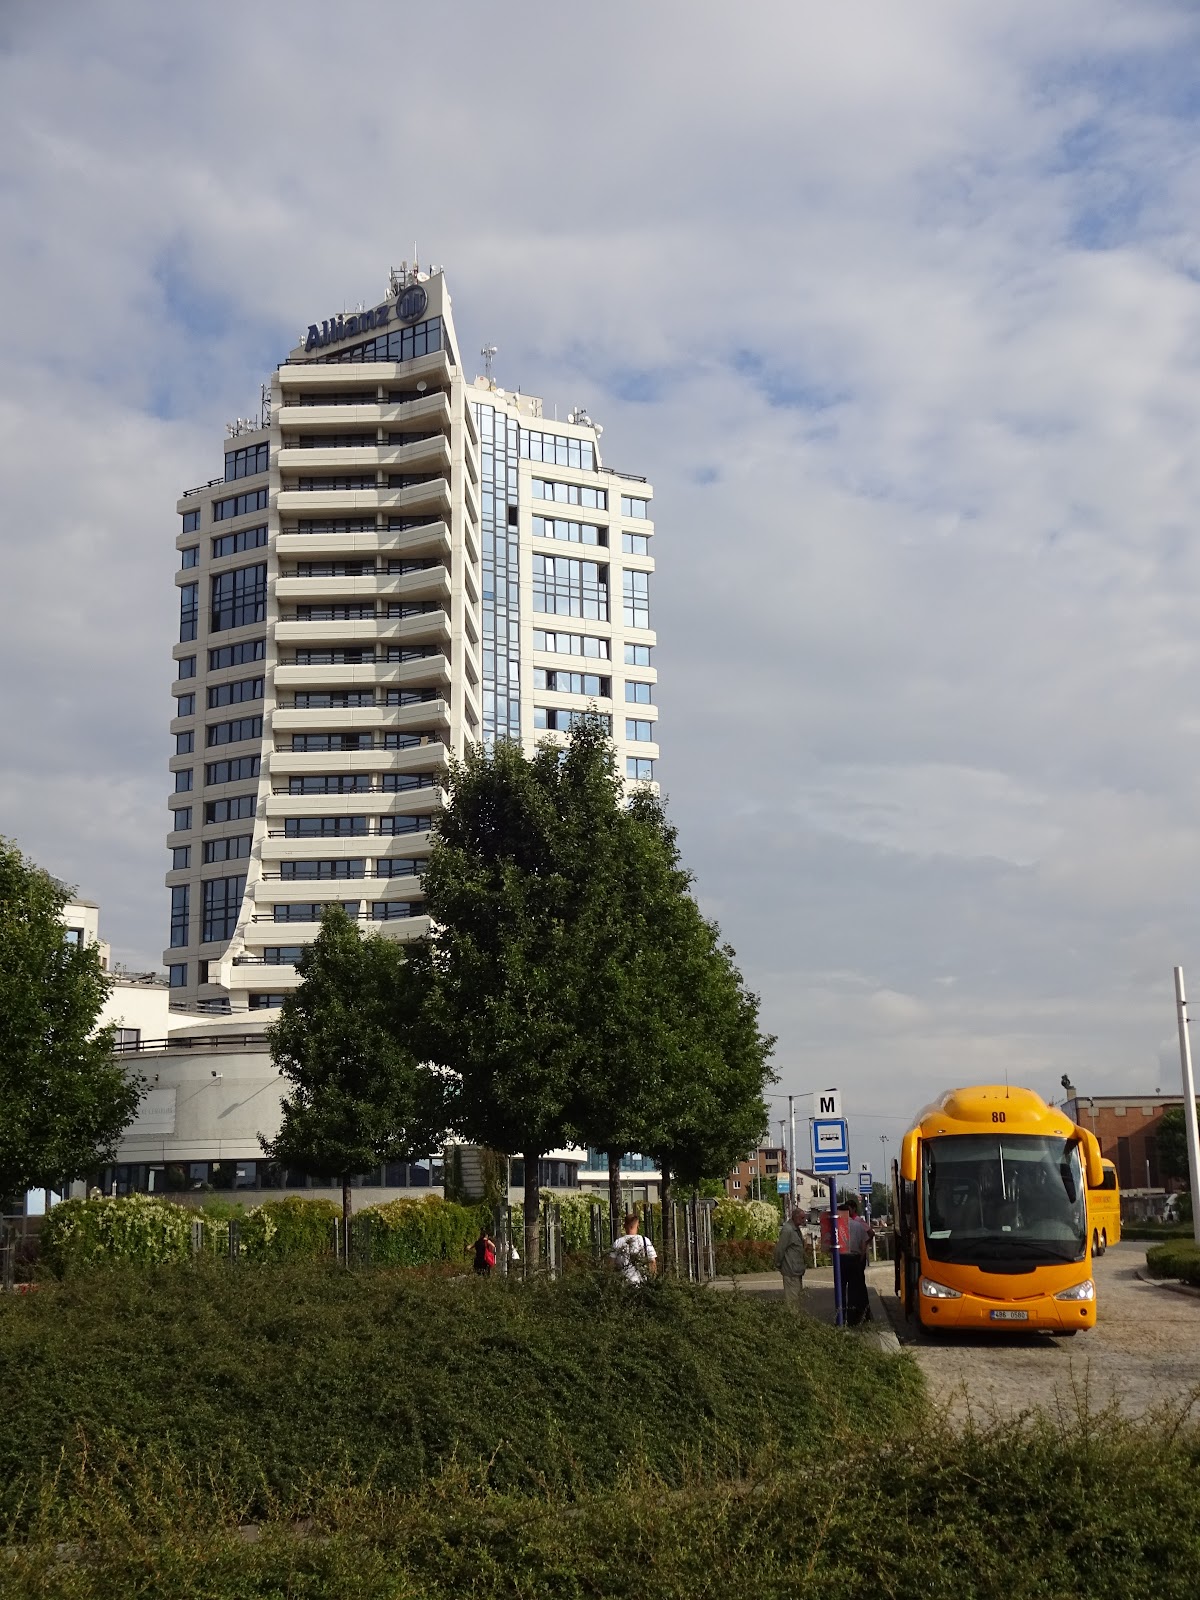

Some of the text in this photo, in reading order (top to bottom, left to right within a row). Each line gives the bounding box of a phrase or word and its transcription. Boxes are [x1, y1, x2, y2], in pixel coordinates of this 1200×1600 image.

[305, 305, 390, 352] Allianz
[820, 1097, 835, 1113] M
[991, 1111, 1006, 1123] 80
